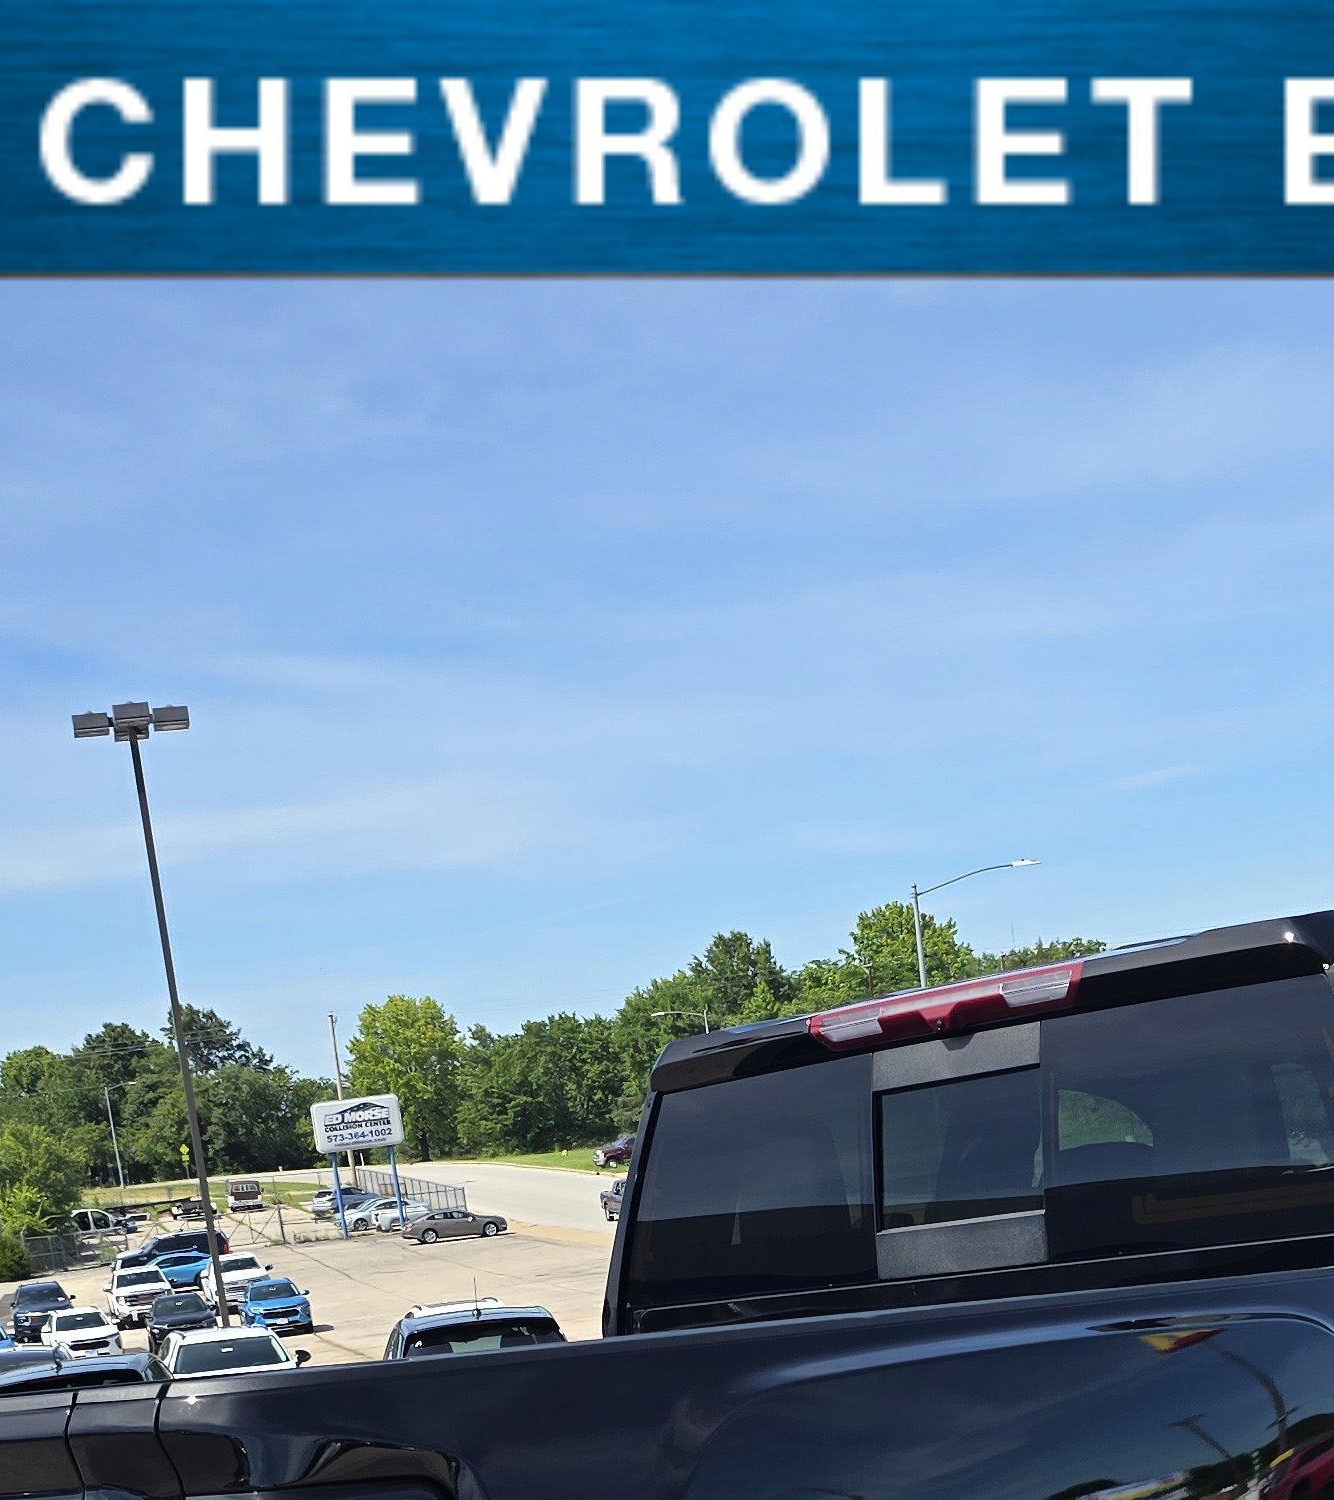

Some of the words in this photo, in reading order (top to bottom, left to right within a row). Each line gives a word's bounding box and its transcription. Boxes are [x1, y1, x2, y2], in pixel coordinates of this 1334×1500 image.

[324, 1113, 343, 1126] ED
[344, 1106, 390, 1123] MORSE
[324, 1122, 363, 1133] COLLISION
[364, 1119, 391, 1128] CENTER
[326, 1127, 393, 1143] 573-364-1002
